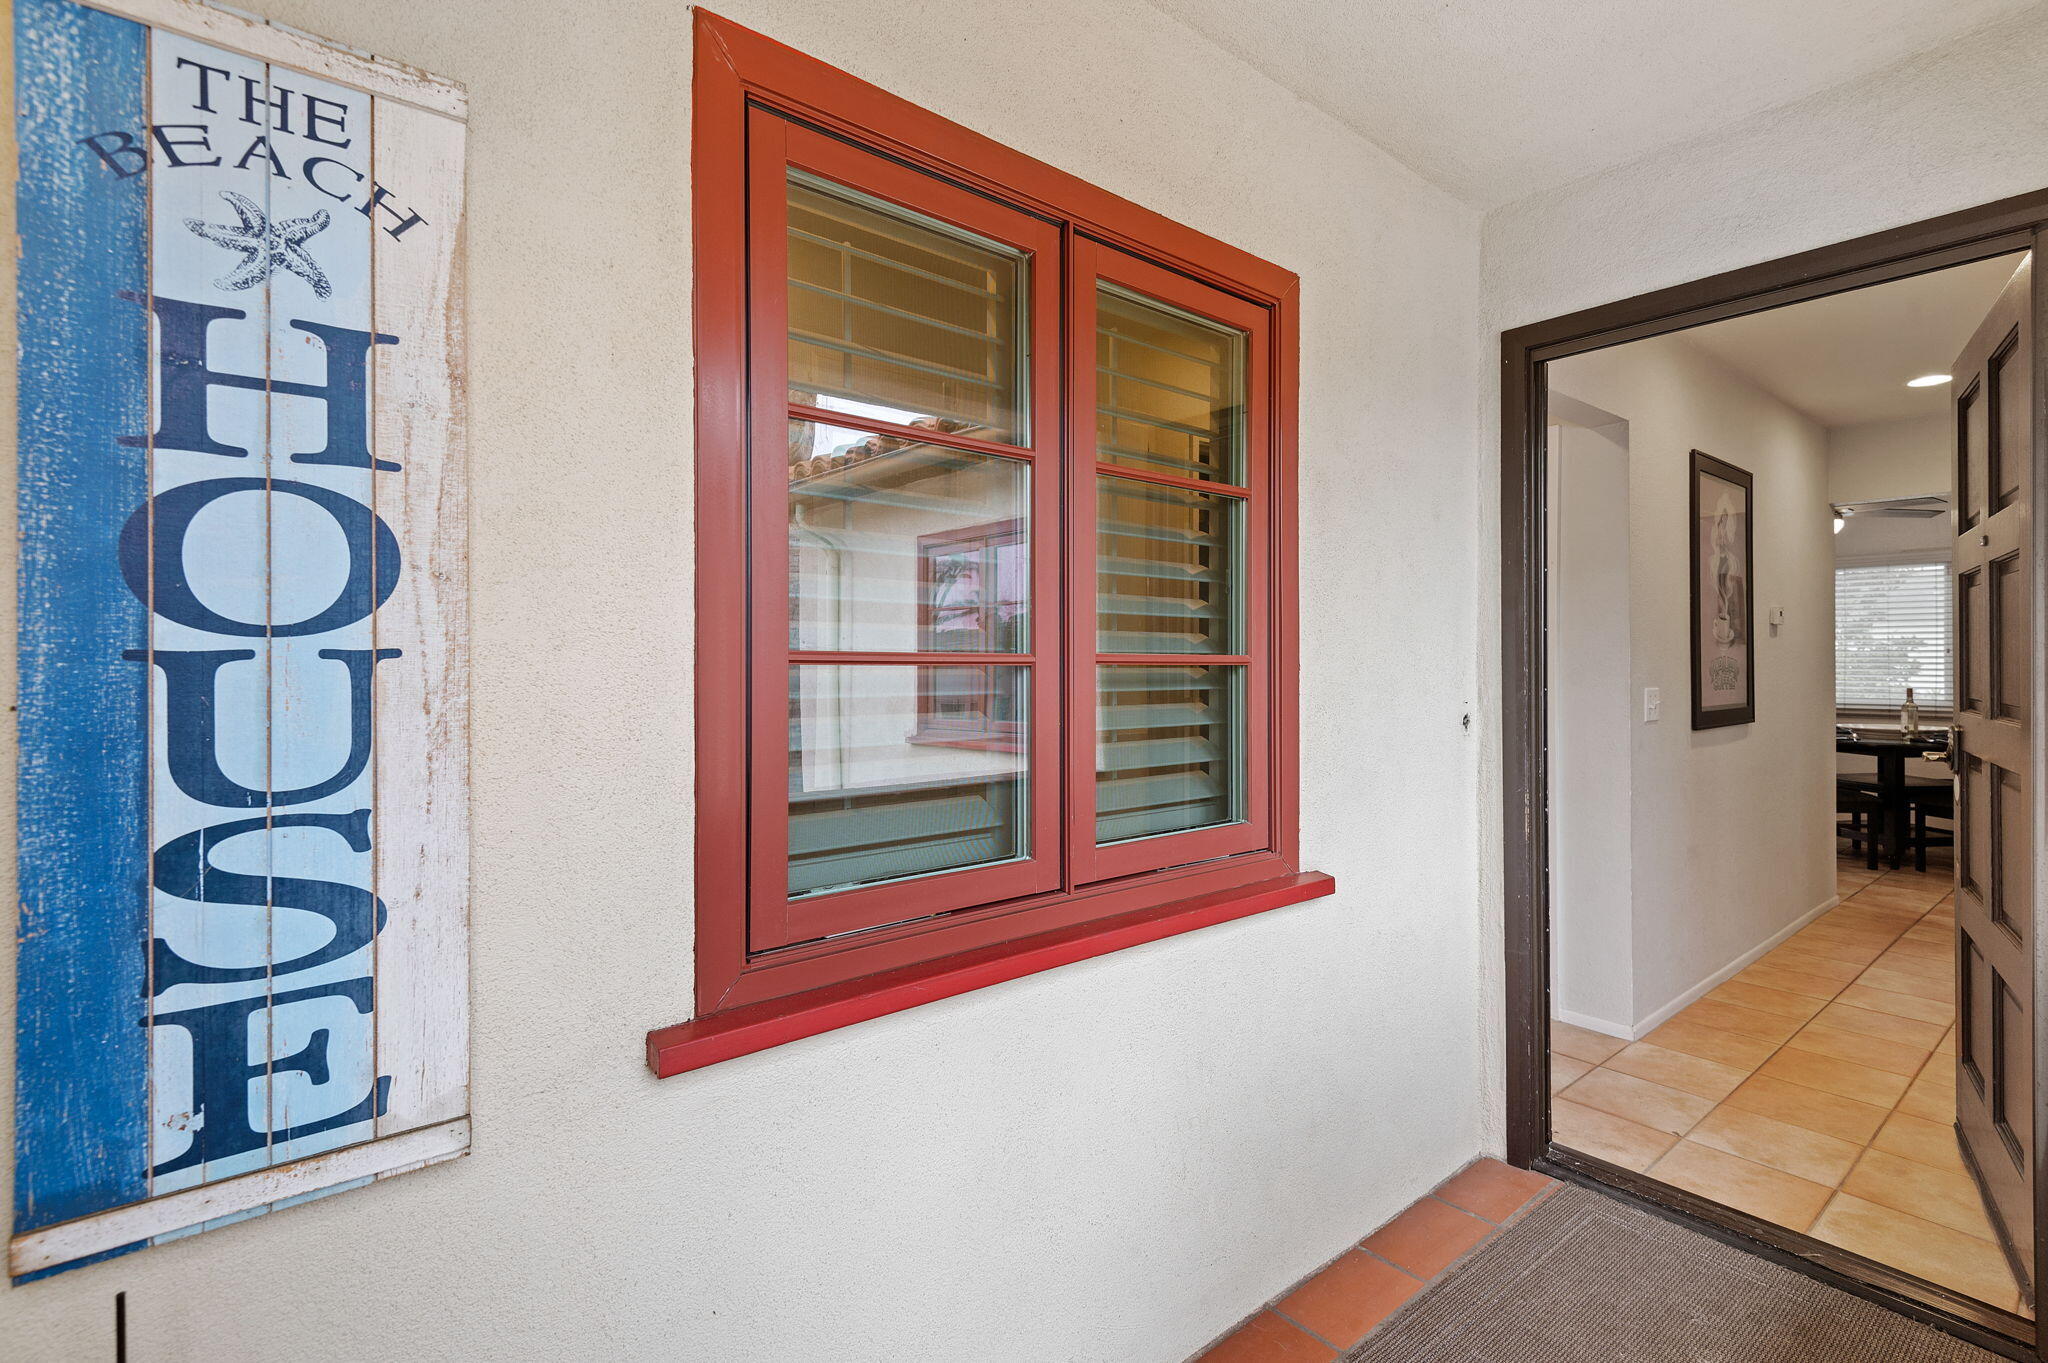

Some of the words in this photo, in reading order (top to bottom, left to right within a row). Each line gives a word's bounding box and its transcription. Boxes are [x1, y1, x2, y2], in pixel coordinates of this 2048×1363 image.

[176, 57, 352, 150] THE
[77, 124, 429, 243] BEACH
[116, 290, 402, 1177] HOUSE
